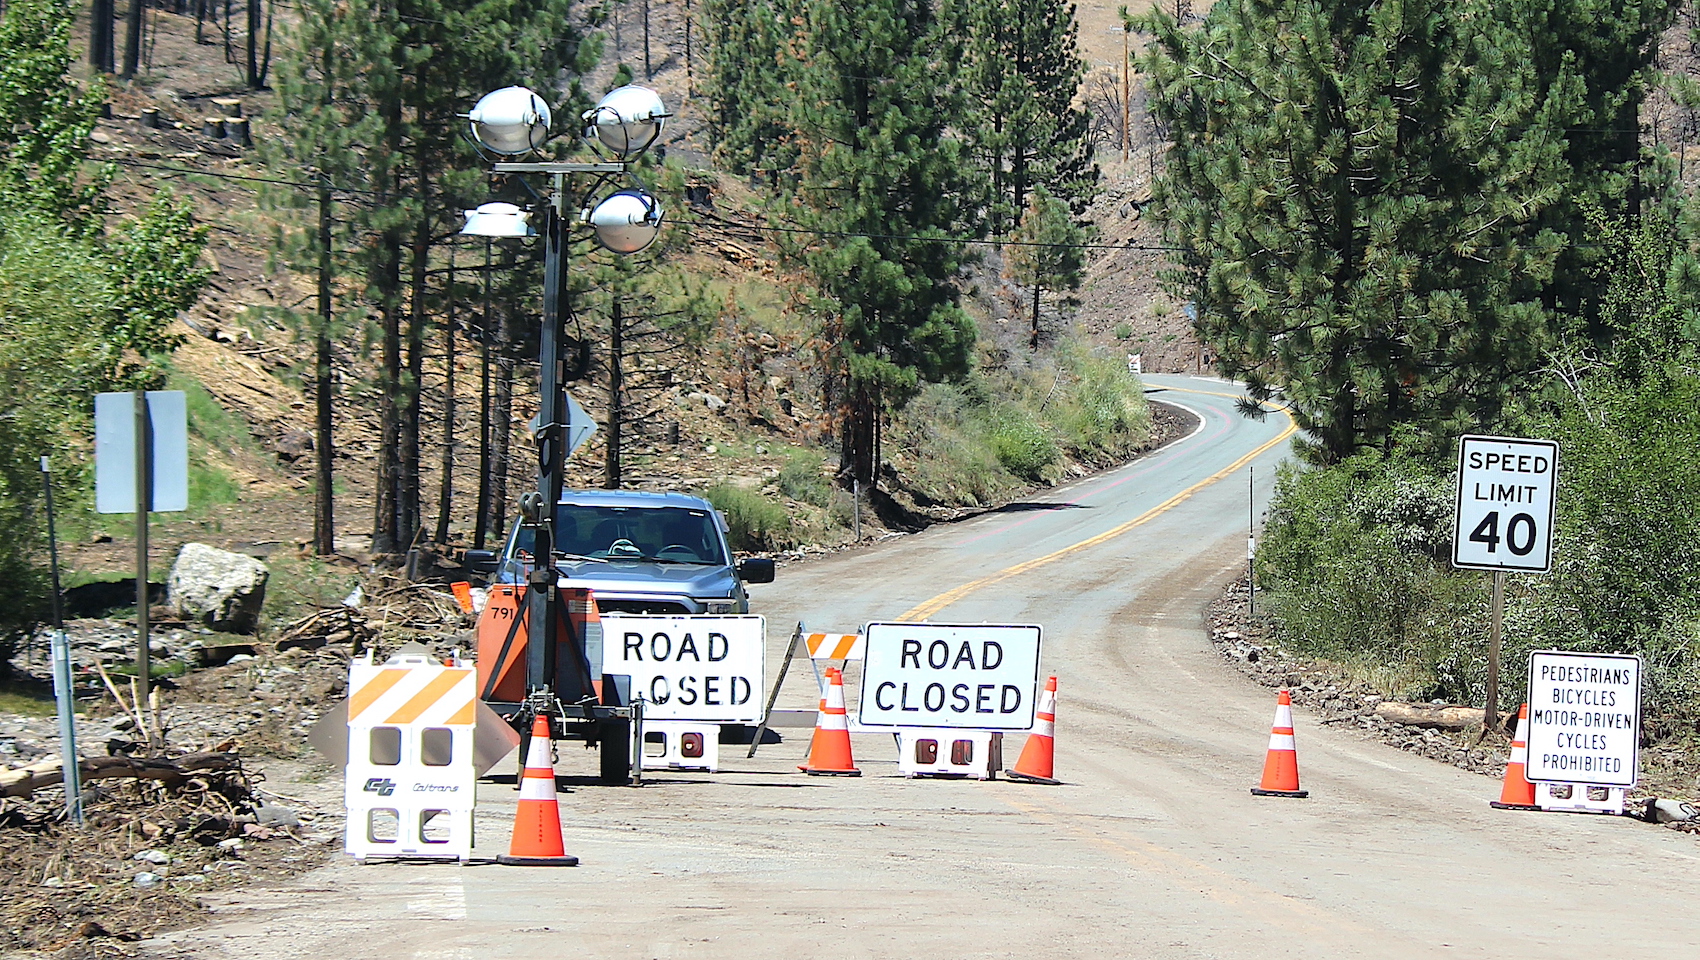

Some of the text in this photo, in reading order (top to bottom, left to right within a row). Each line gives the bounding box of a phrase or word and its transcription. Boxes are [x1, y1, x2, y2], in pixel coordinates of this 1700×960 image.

[1468, 451, 1548, 474] SPEED
[1475, 482, 1538, 504] LIMIT
[1468, 511, 1537, 556] 40
[491, 607, 514, 620] 791
[623, 632, 729, 662] ROAD
[900, 639, 1003, 670] ROAD
[1541, 665, 1630, 685] PEDESTRIANS
[650, 675, 751, 706] OSED
[875, 681, 1022, 714] CLOSED
[1553, 688, 1616, 707] BICYCLES
[1534, 709, 1632, 729] MOTOR-DRIVEN
[1557, 732, 1607, 751] CYCLES
[1543, 753, 1621, 773] PROHIBITED
[412, 782, 459, 792] Caltrans
